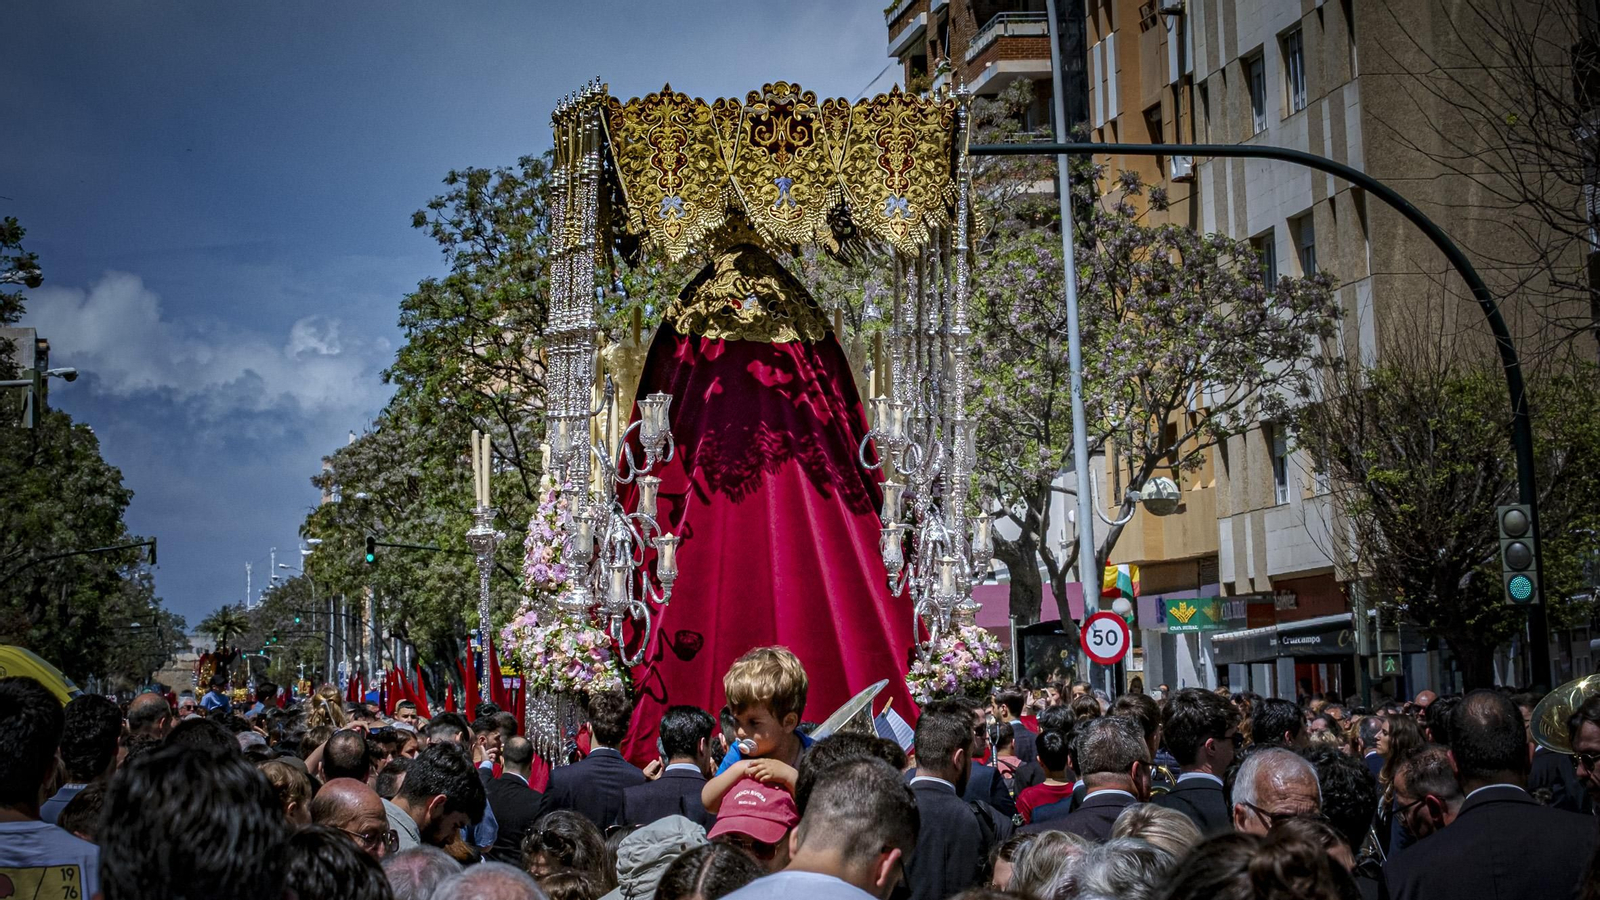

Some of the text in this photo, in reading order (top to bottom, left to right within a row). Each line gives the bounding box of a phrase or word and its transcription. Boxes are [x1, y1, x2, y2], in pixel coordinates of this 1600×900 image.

[1092, 629, 1118, 646] 50
[1282, 636, 1321, 644] Cruzcampo
[60, 867, 75, 882] 19
[61, 885, 79, 899] 76
